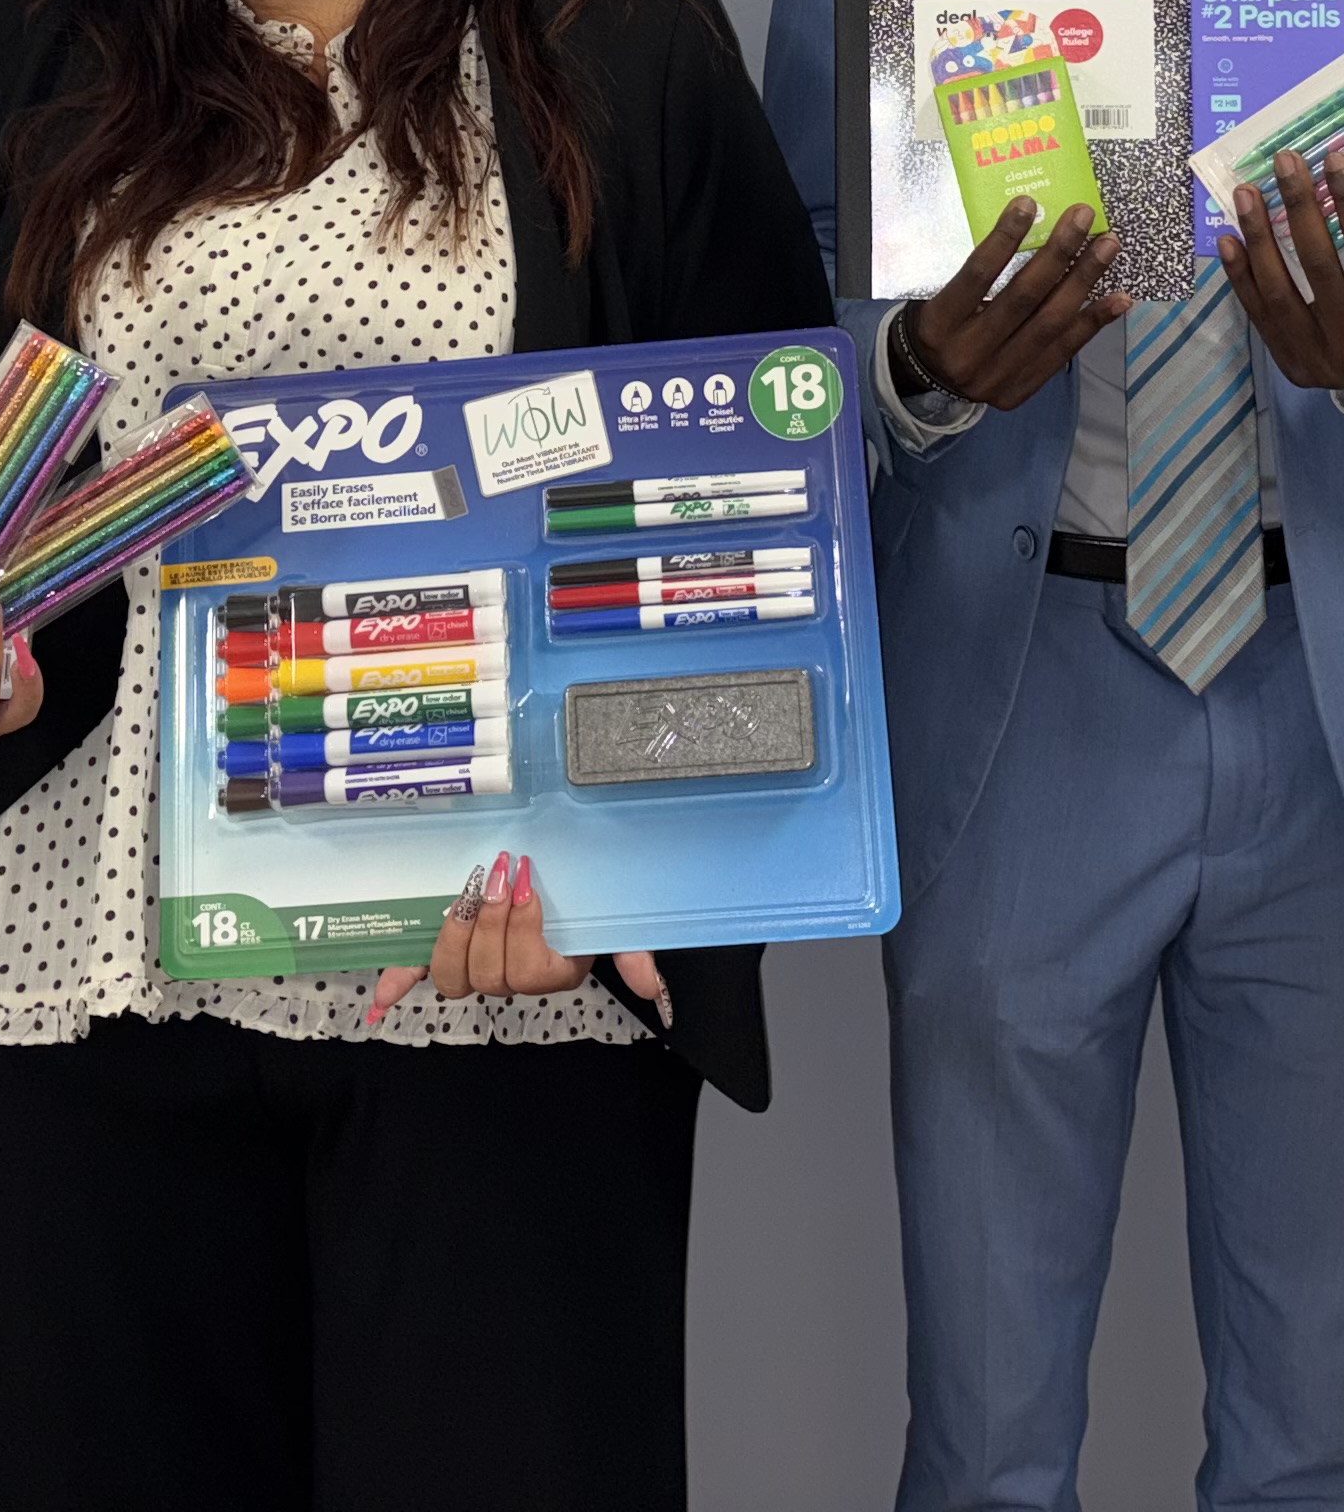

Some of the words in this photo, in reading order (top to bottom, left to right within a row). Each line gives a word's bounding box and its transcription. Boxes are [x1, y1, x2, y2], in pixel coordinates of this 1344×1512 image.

[1201, 4, 1232, 29] #2
[1239, 3, 1341, 29] Pencils
[1058, 28, 1093, 37] College
[1063, 38, 1090, 46] Ruled
[1216, 120, 1236, 134] 24
[976, 134, 1061, 167] LLAMA
[1005, 166, 1044, 182] classic
[1004, 178, 1051, 196] crayons
[760, 364, 826, 412] 18
[618, 415, 639, 425] Ultra
[670, 411, 689, 420] Fine
[708, 406, 734, 416] Chisel
[791, 413, 802, 421] CT
[484, 386, 588, 456] WOW
[618, 423, 639, 432] Ultra
[671, 419, 689, 427] Fina
[709, 423, 735, 433] Cincel
[221, 395, 423, 503] EXPO
[290, 485, 328, 499] Easily
[332, 482, 374, 495] Erases
[290, 498, 344, 512] S'efface
[347, 492, 419, 507] facilement
[670, 500, 712, 519] EXPO
[290, 515, 307, 526] Se
[310, 511, 347, 524] Borra
[350, 510, 373, 521] con
[377, 503, 436, 519] Facilidad
[353, 593, 417, 615] EXPO
[424, 592, 438, 600] low
[440, 589, 460, 598] odor
[354, 614, 421, 640] EXPO
[352, 696, 419, 724] EXPO
[426, 695, 441, 703] low
[442, 693, 463, 702] odor
[379, 738, 395, 747] dry
[191, 910, 238, 948] 18
[293, 915, 325, 941] 17
